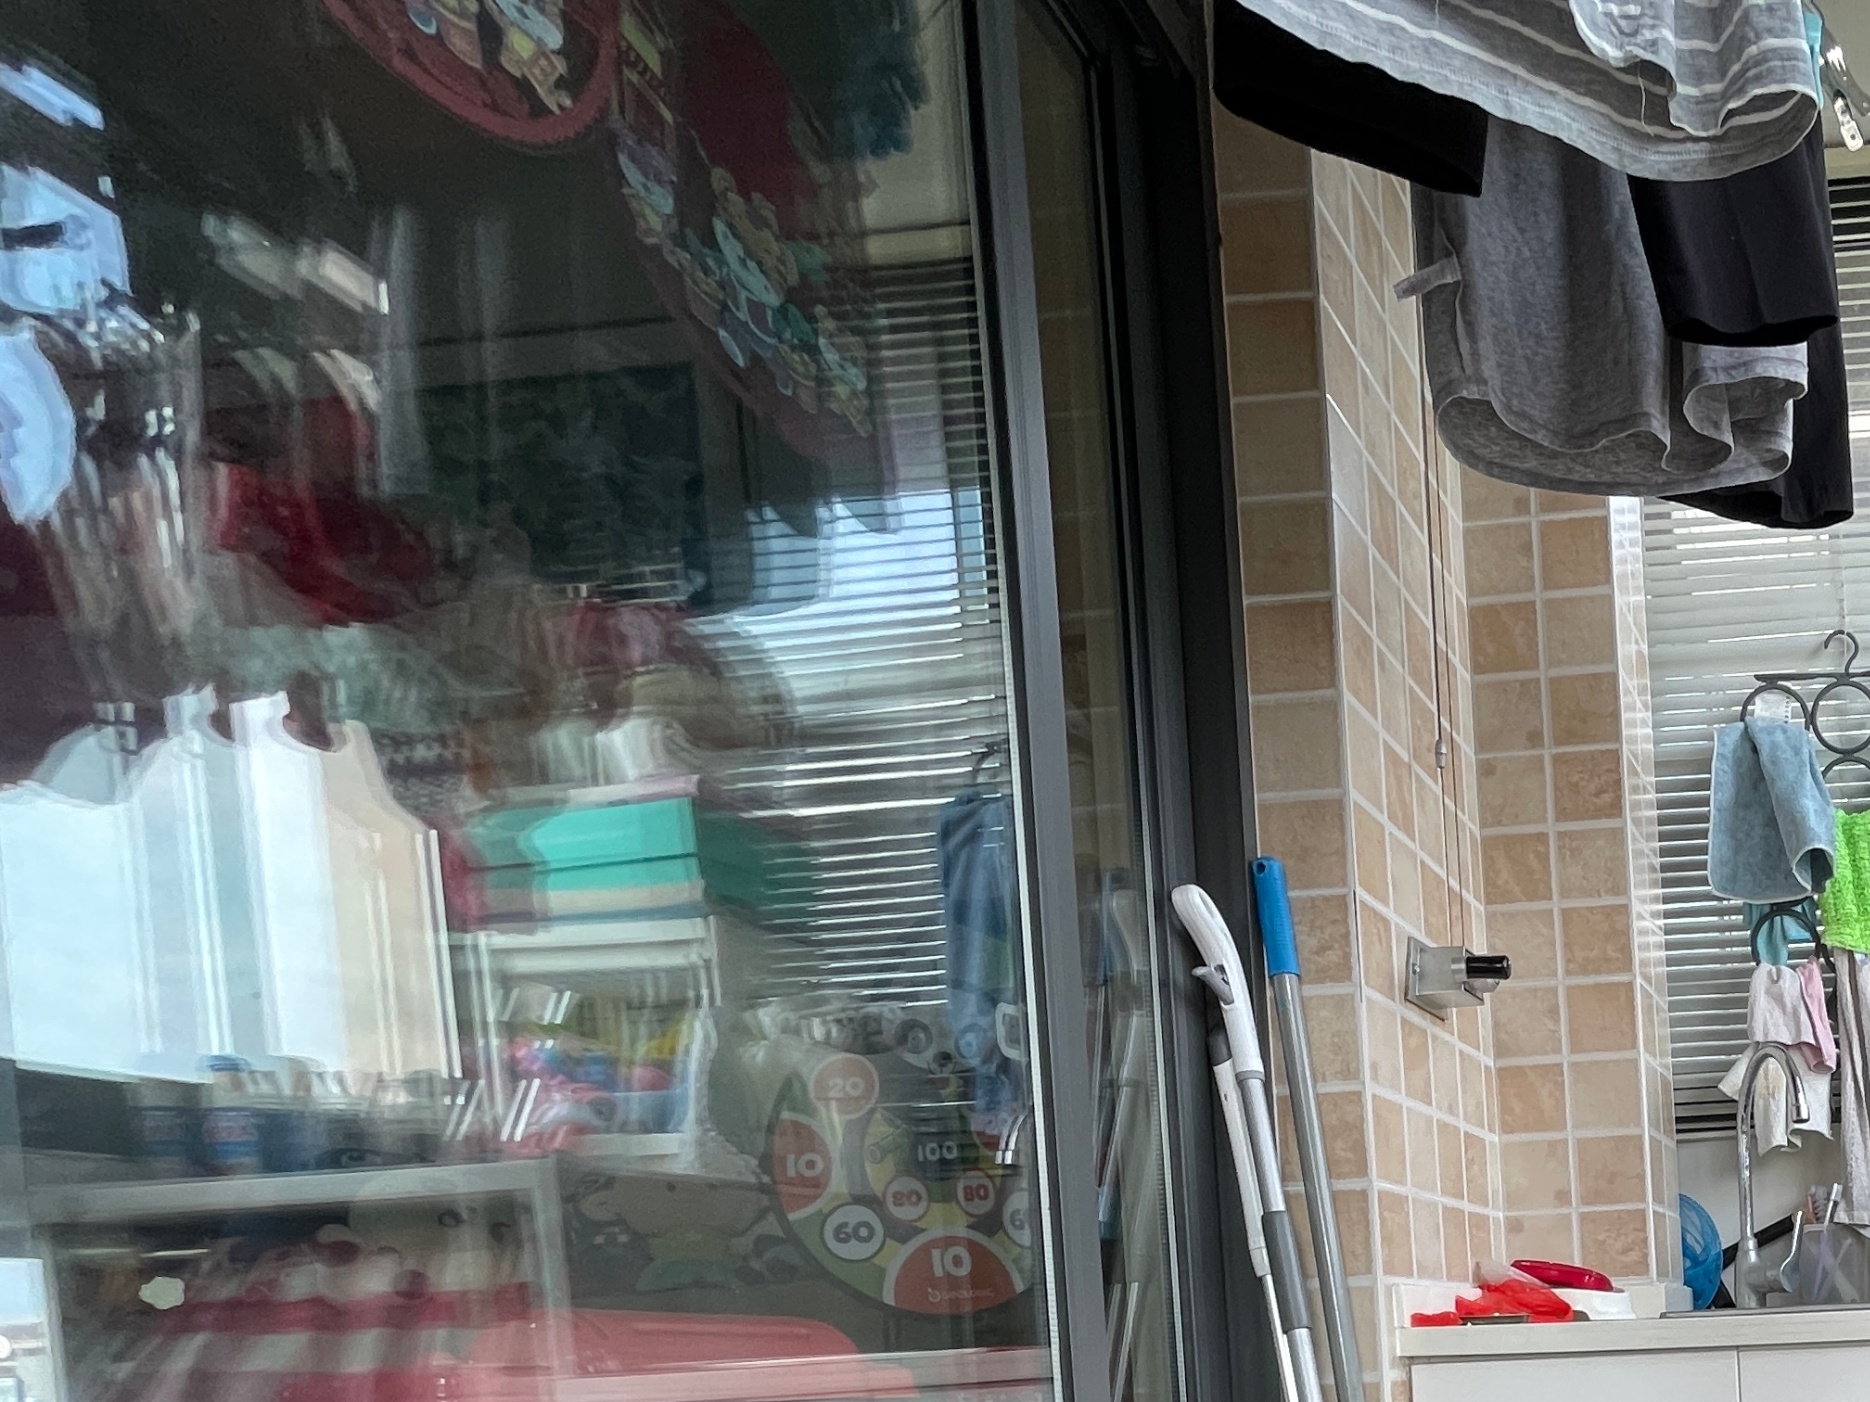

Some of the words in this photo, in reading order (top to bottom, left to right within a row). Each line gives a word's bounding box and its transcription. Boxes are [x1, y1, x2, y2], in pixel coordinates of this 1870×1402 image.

[827, 1077, 865, 1099] 20
[917, 1141, 958, 1162] 100
[786, 1152, 825, 1178] 10
[962, 1183, 990, 1203] 80
[1009, 1207, 1030, 1232] 6
[832, 1220, 876, 1245] 60
[931, 1245, 973, 1278] 10
